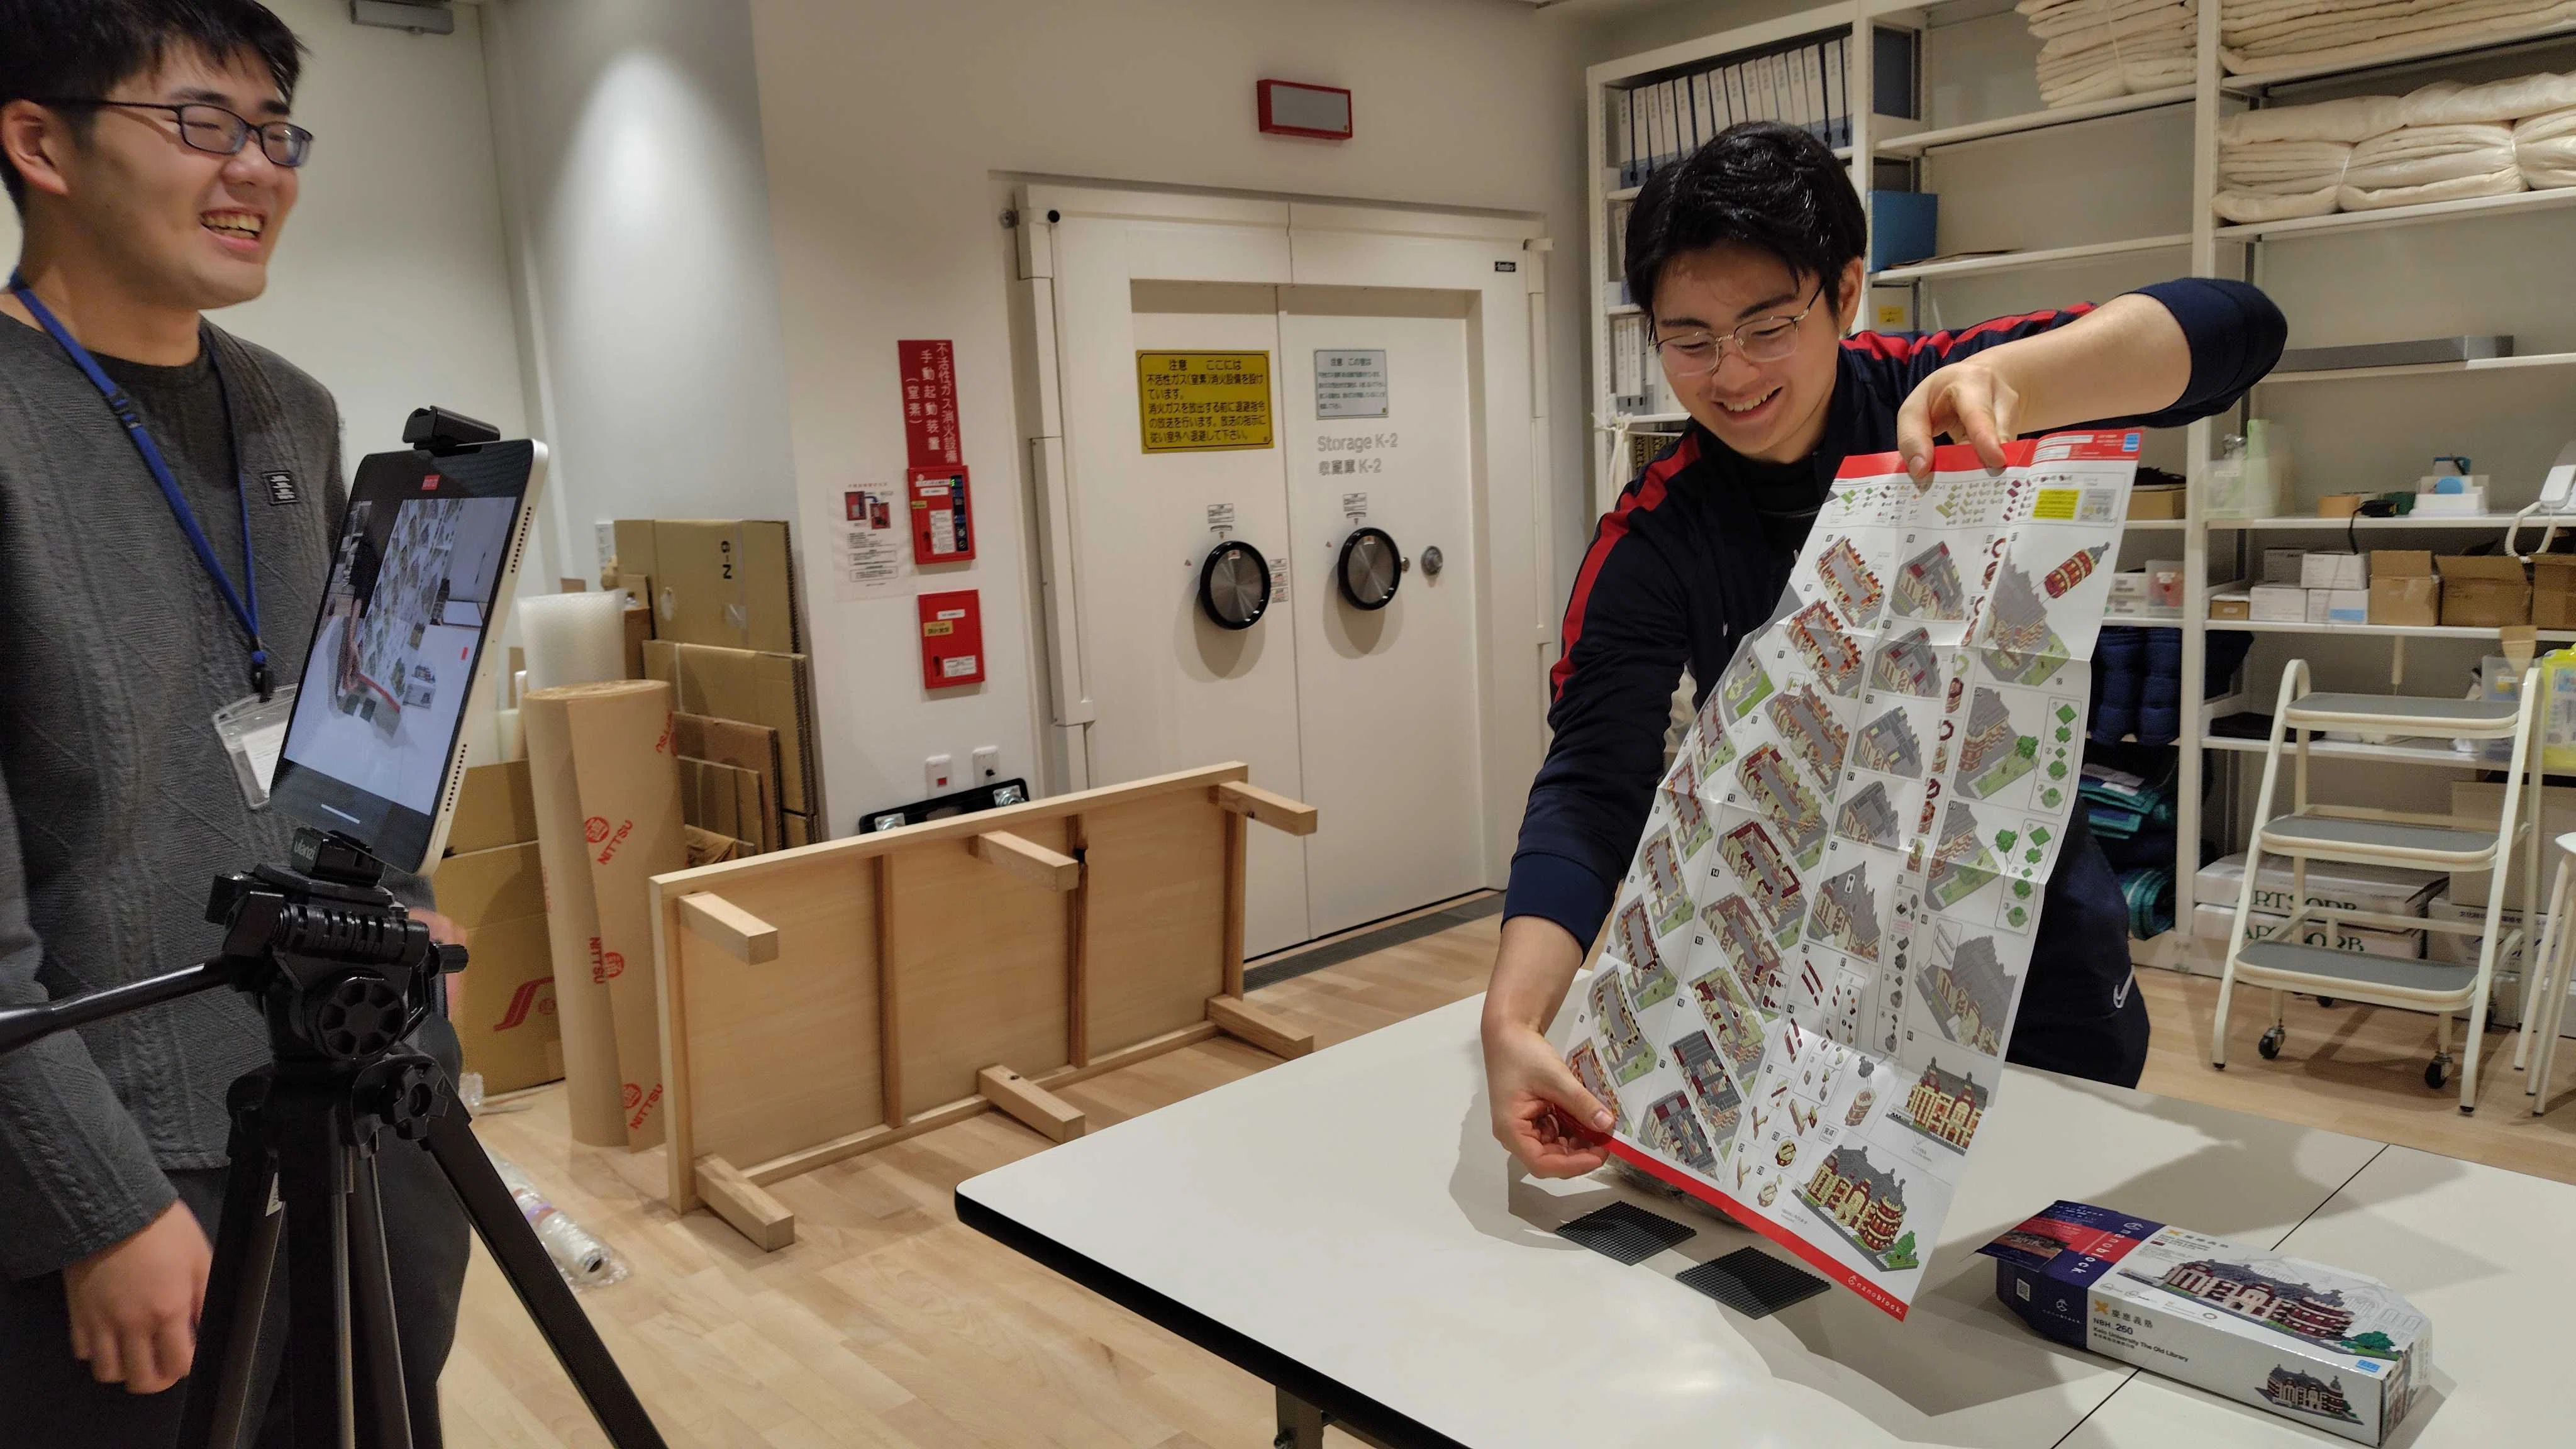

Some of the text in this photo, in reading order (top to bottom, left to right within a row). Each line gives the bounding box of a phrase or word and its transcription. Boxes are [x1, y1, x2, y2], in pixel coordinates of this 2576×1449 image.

[1169, 359, 1242, 371] 注意 ここには
[920, 350, 941, 451] 手動起動装置
[936, 343, 958, 464] 不活性ガス消火設備
[1317, 432, 1399, 453] Storage K-2
[1358, 458, 1382, 474] K-2
[596, 819, 633, 865] NITTSU
[589, 937, 605, 984] NITTSU
[630, 1084, 663, 1130] NITTSU
[2071, 1230, 2131, 1274] nanoblock
[1856, 1283, 1901, 1313] nanoblock
[2108, 1330, 2138, 1346] University
[2140, 1341, 2152, 1350] The
[2153, 1346, 2165, 1354] Old
[2165, 1350, 2189, 1362] Library
